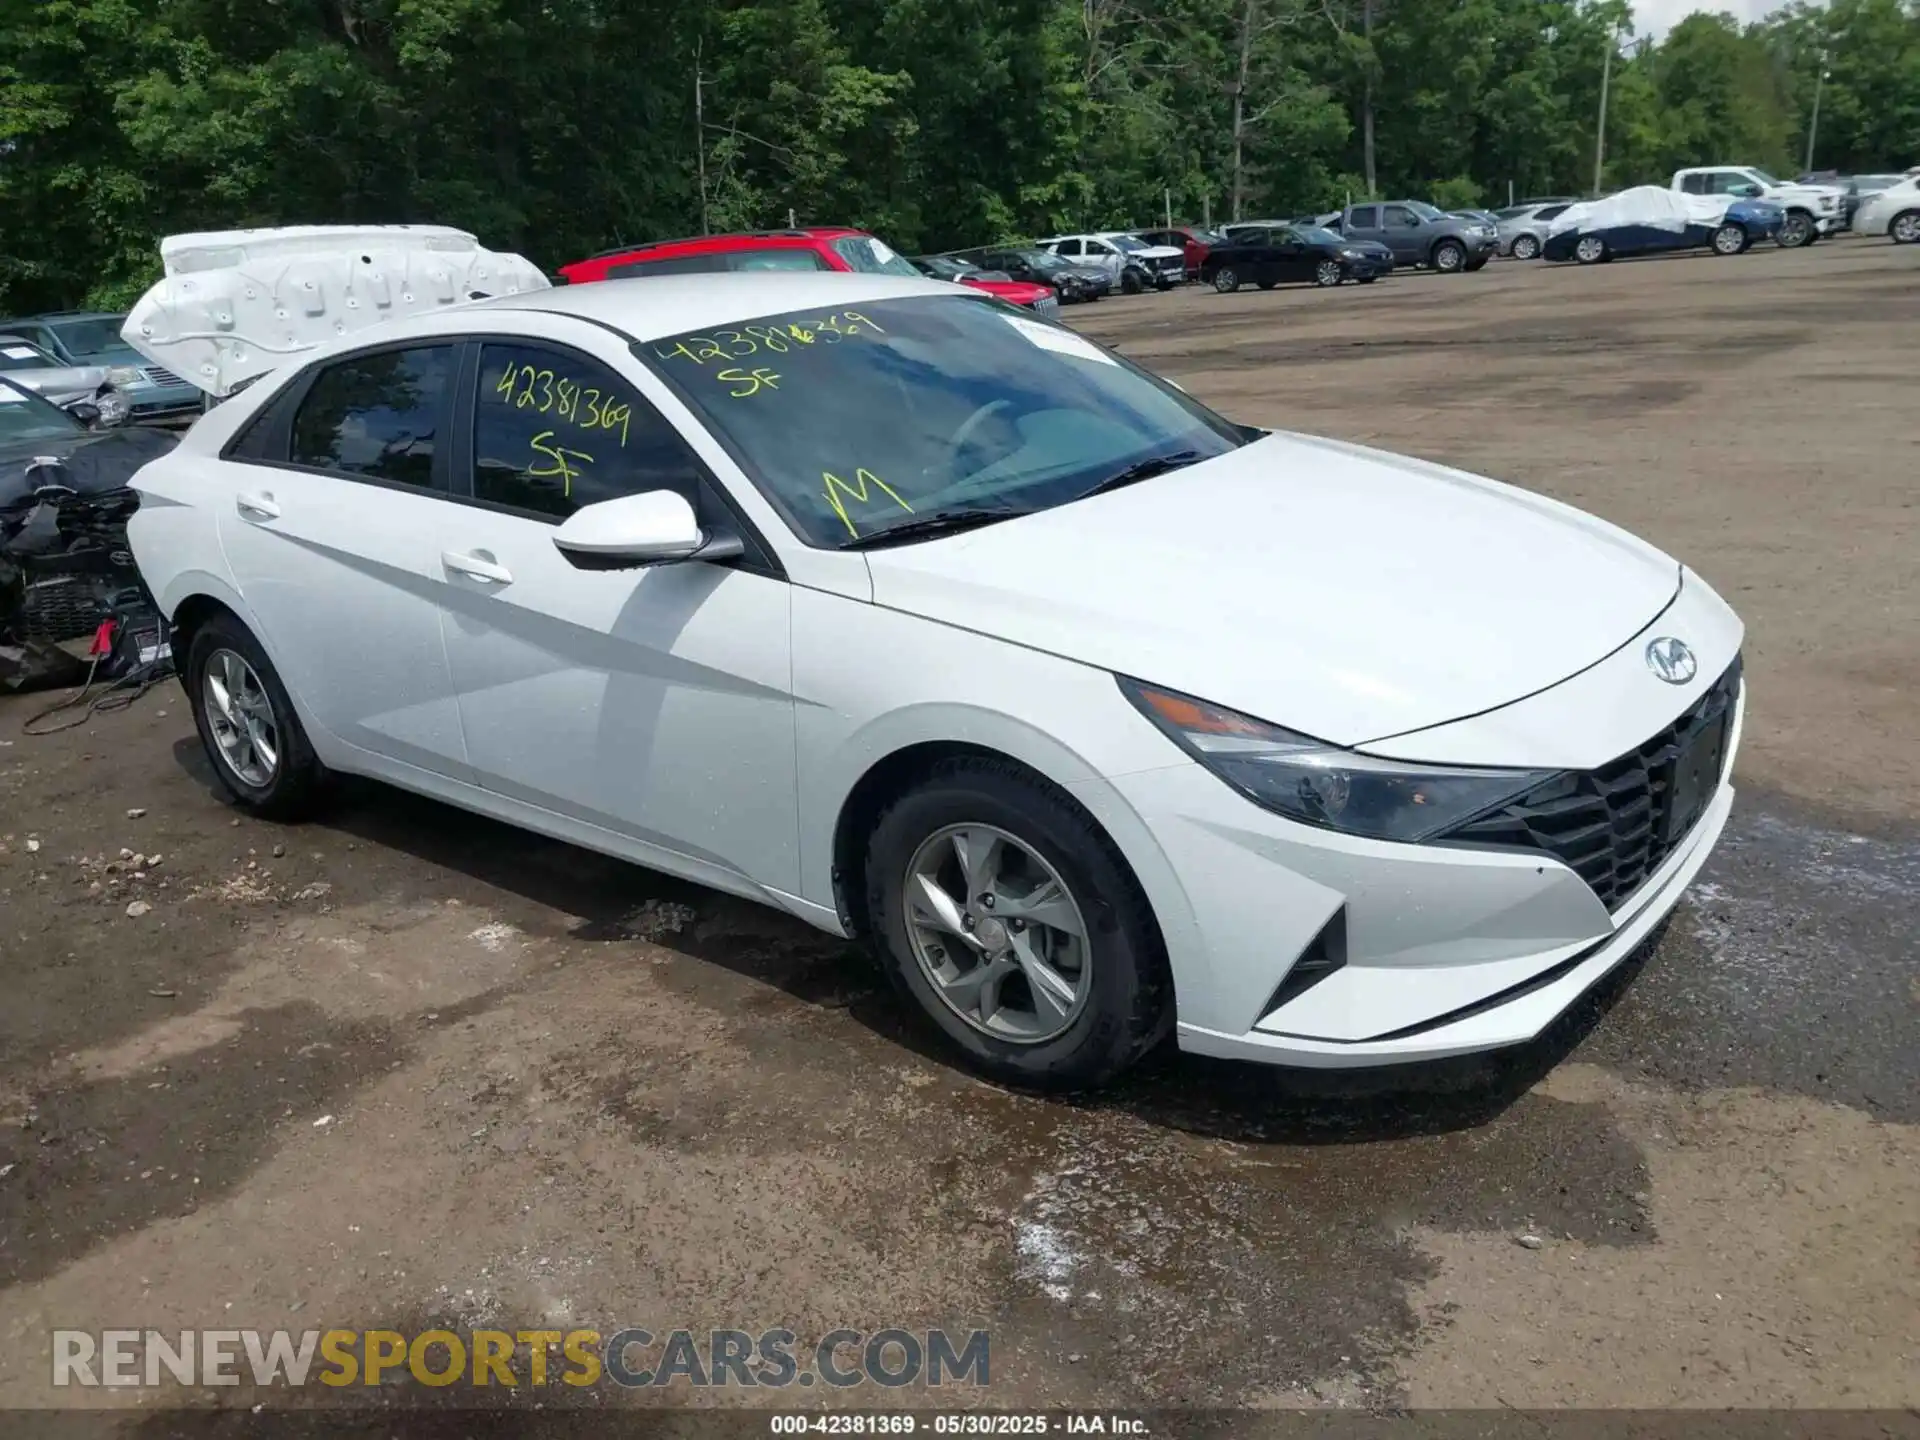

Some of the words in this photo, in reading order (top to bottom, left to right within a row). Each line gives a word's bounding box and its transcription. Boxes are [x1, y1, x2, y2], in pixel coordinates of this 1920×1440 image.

[497, 361, 631, 448] 42381369
[717, 367, 782, 398] SF
[528, 431, 594, 497] SF
[821, 467, 916, 540] M
